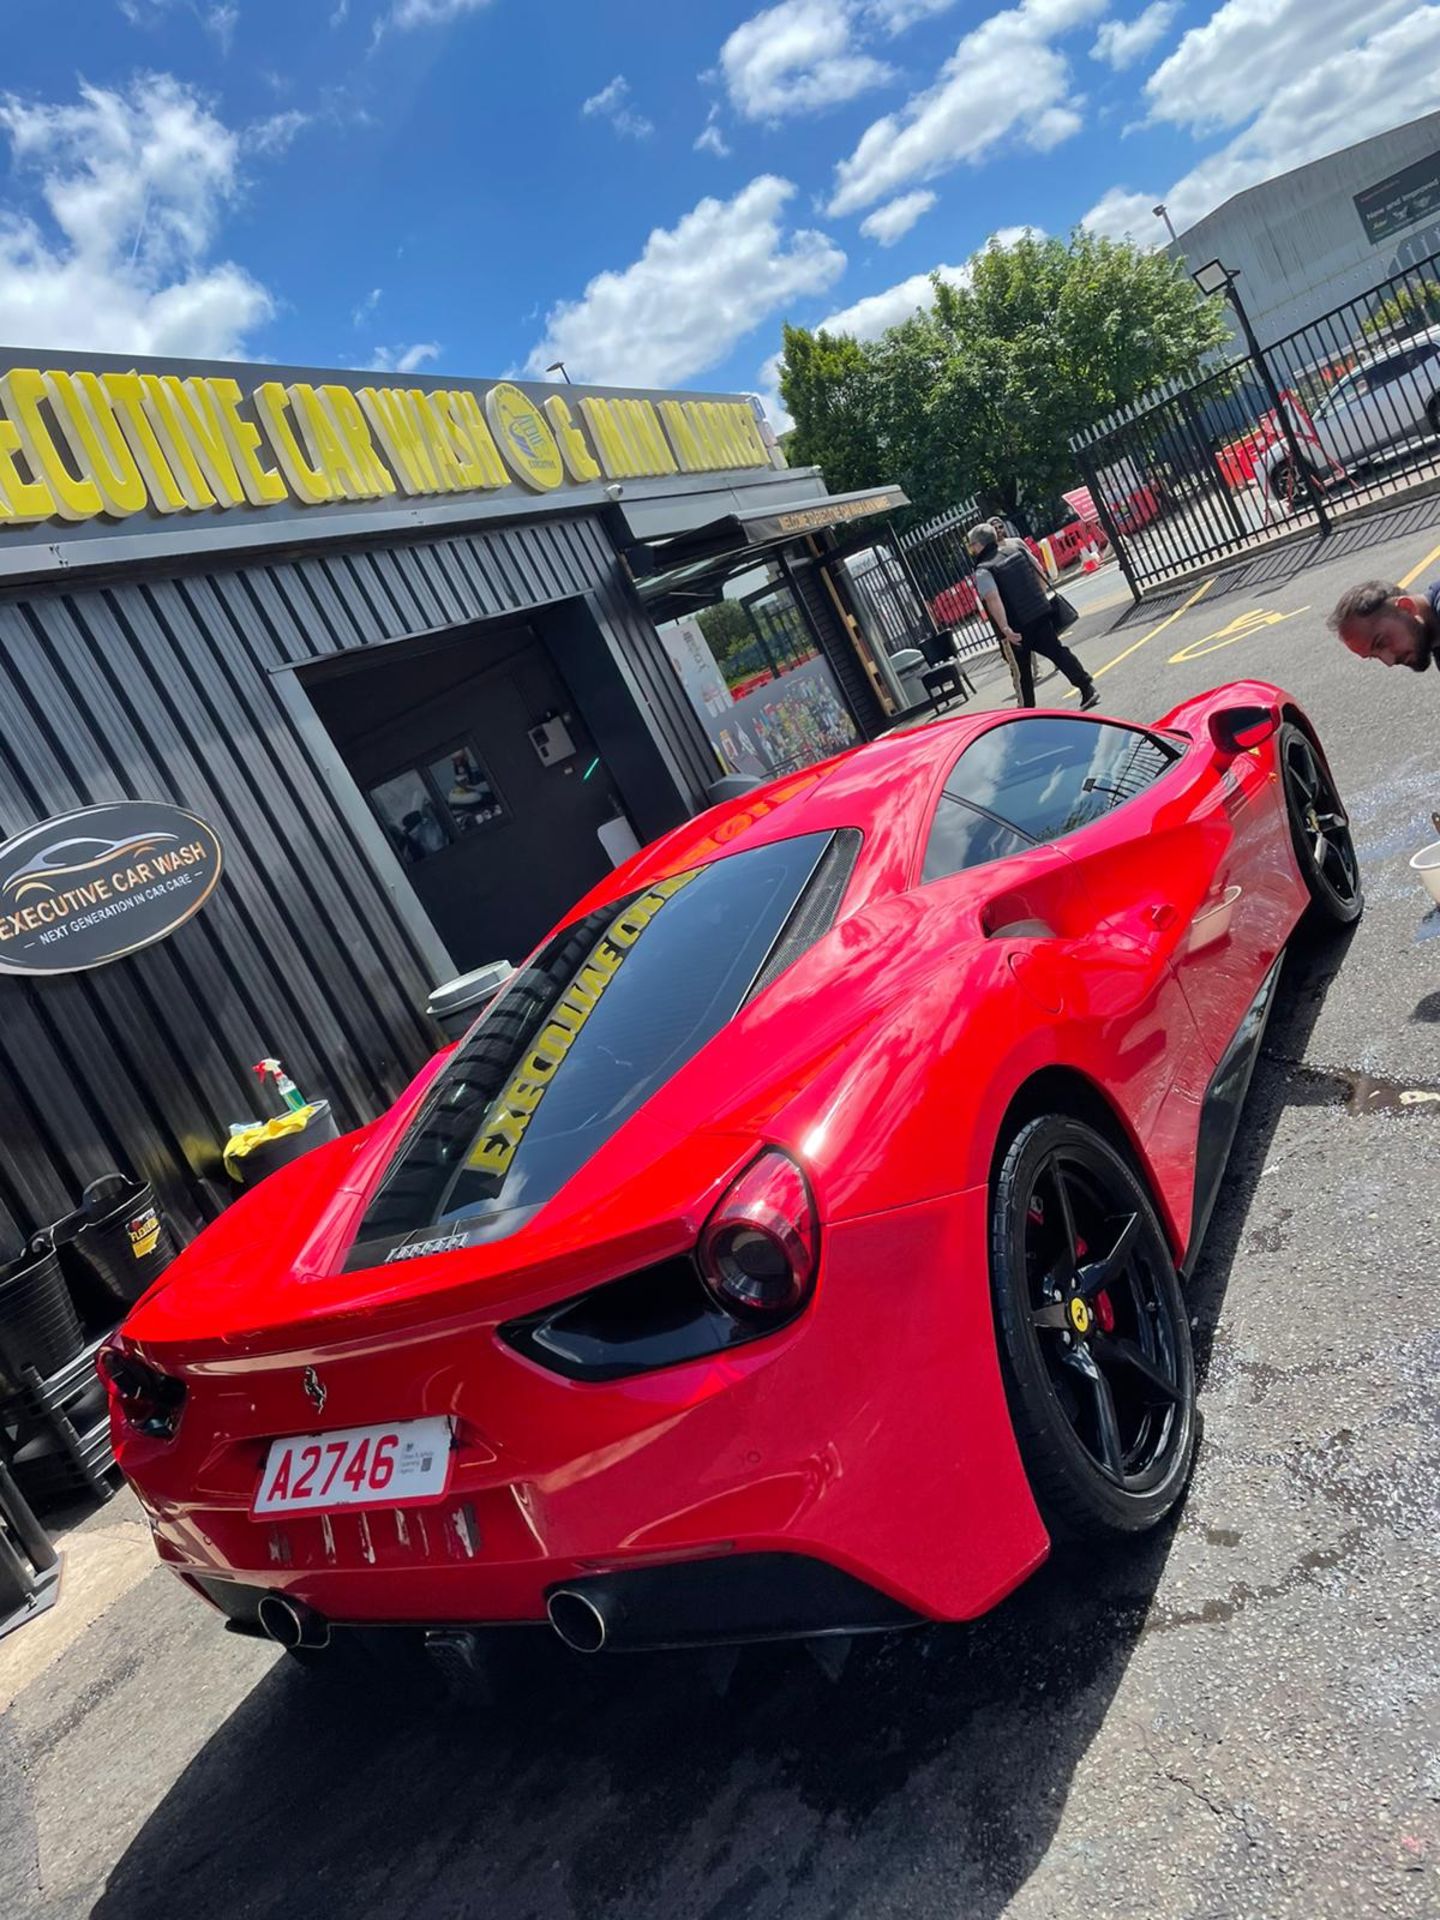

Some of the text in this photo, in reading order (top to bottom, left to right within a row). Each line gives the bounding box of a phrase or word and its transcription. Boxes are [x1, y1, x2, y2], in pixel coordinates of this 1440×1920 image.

[0, 367, 288, 518] ECUTIVE
[253, 382, 396, 504] CAR
[355, 387, 510, 496] WASH
[578, 396, 679, 479] MINI
[656, 400, 771, 473] MARKET
[0, 841, 207, 941] EXECUTIVE CAR WASH
[40, 873, 193, 946] NEXT GENERATION IN CAR CARE
[266, 1434, 400, 1502] A2746
